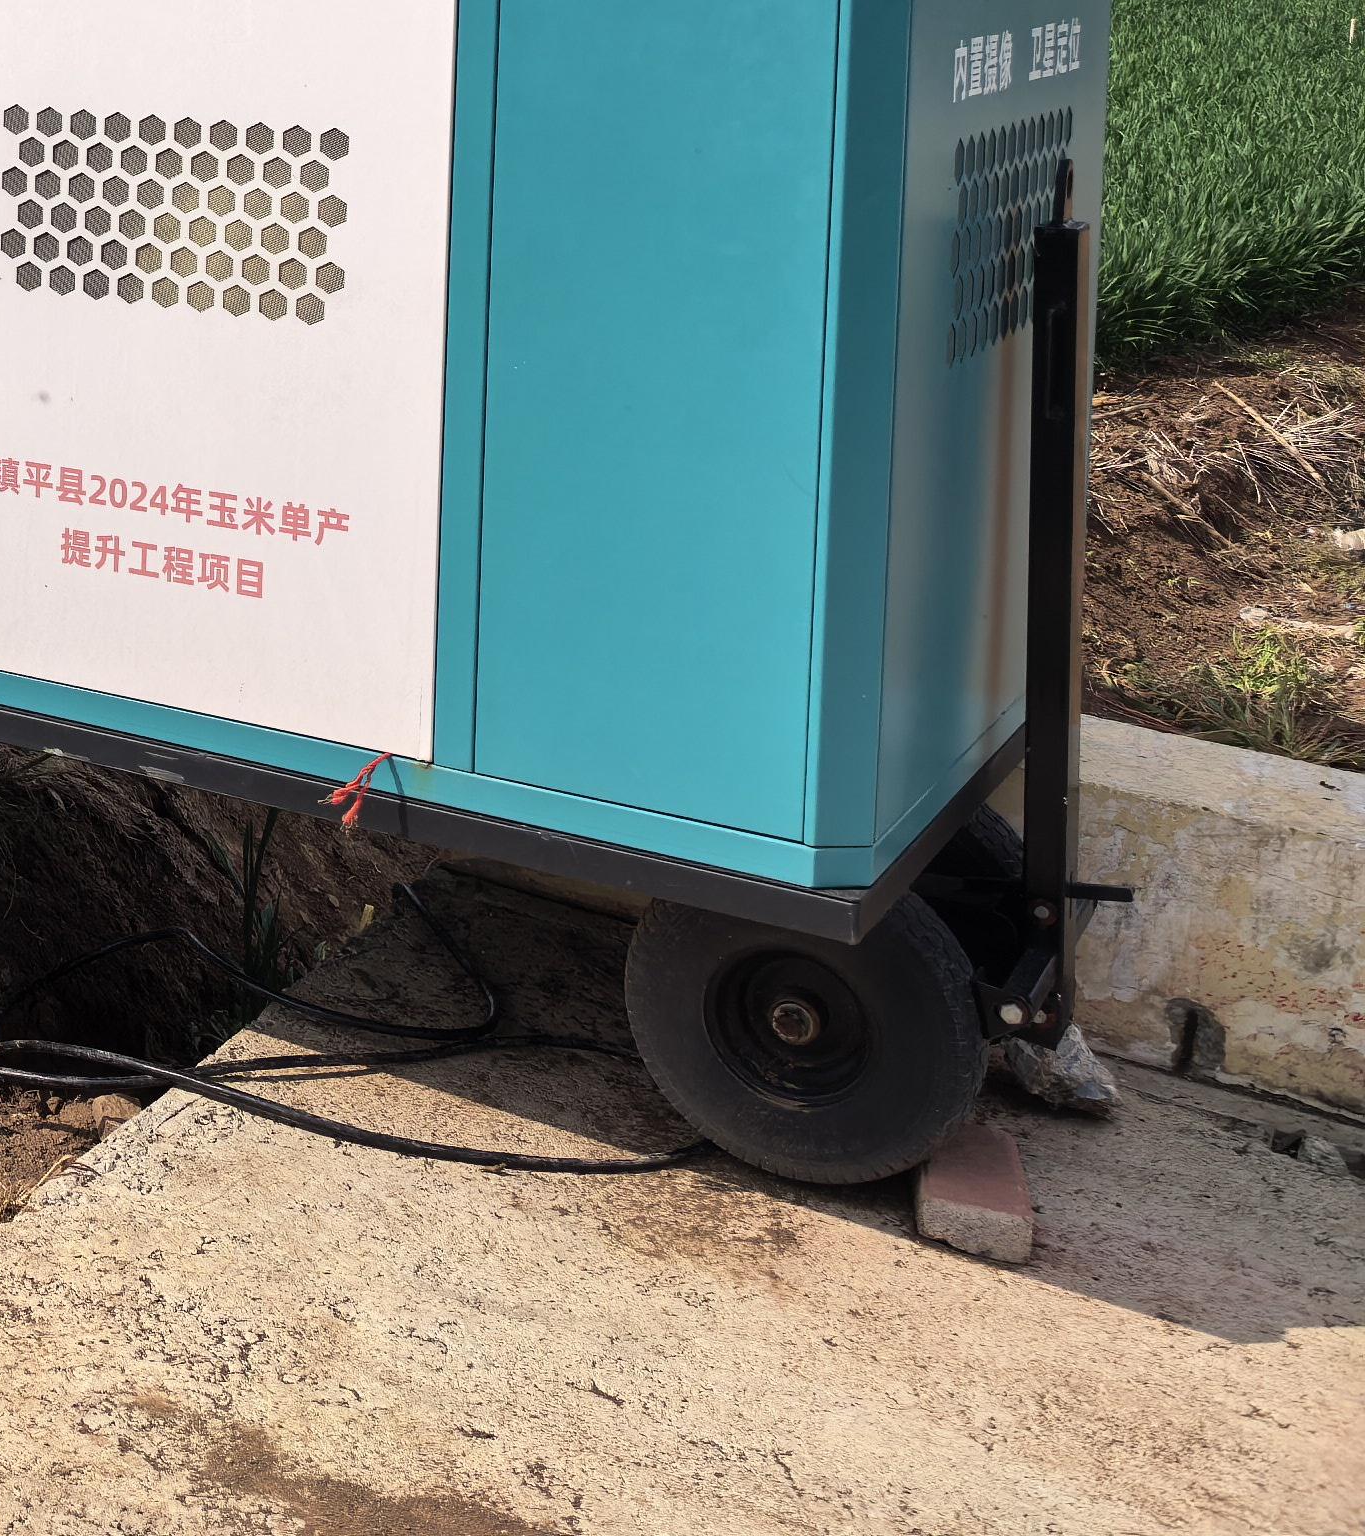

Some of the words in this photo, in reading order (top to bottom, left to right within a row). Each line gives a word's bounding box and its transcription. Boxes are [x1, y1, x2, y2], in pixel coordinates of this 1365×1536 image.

[1028, 17, 1081, 81] 卫星定位
[60, 527, 264, 599] 提升工程项目
